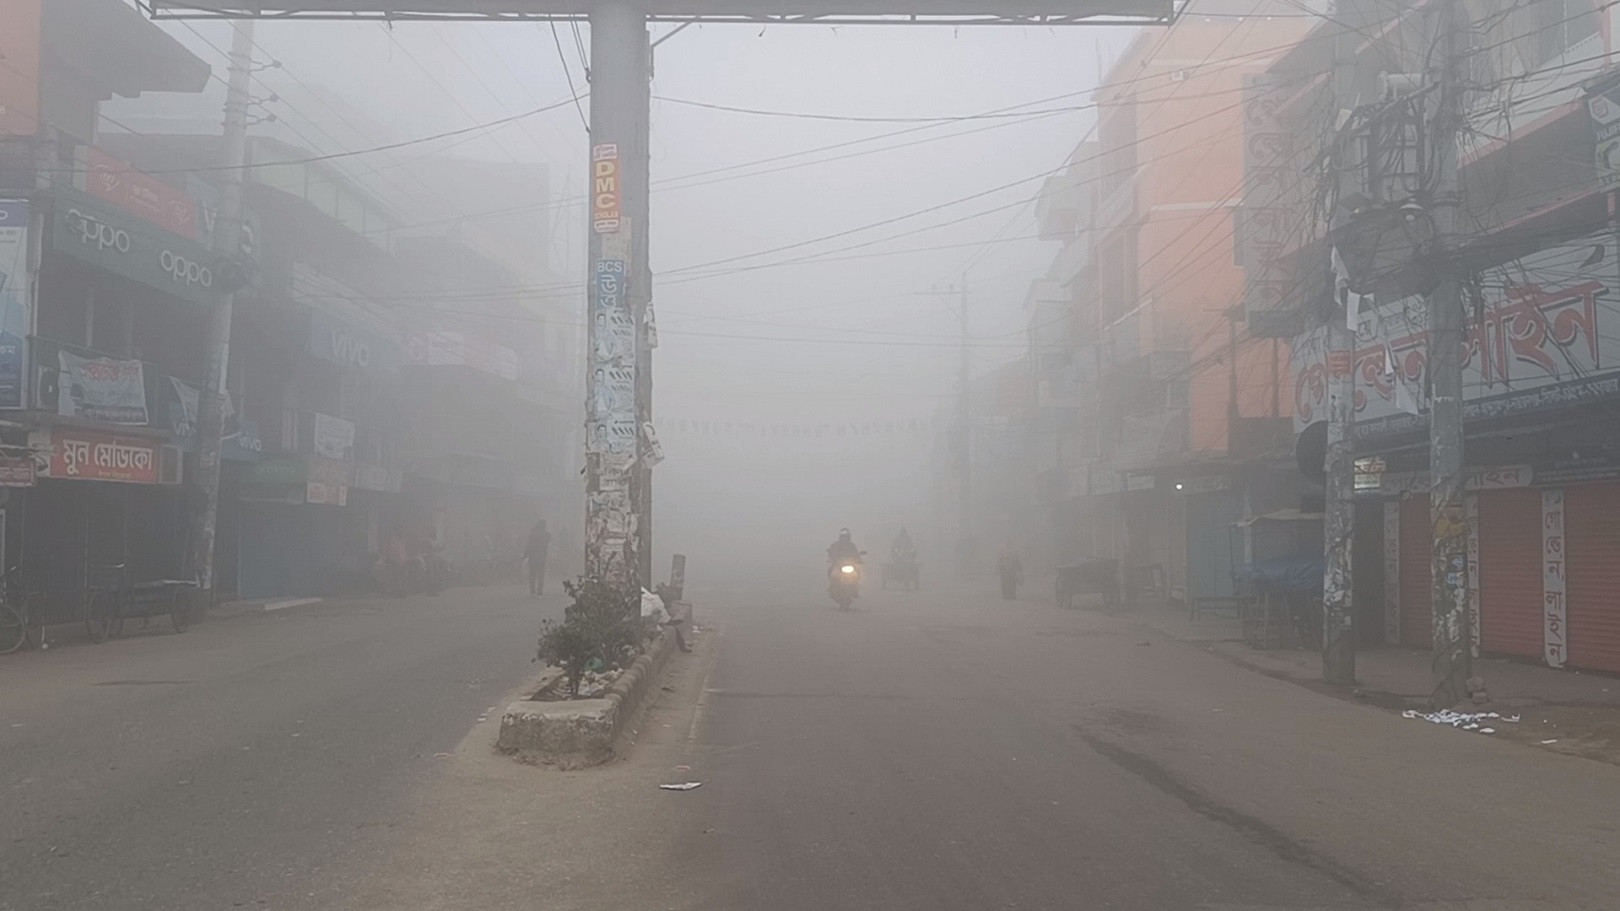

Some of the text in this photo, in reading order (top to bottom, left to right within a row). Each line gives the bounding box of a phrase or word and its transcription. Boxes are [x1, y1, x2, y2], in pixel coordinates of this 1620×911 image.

[596, 161, 616, 209] DMC
[65, 208, 131, 253] oppo
[160, 249, 212, 288] oppo
[597, 261, 622, 272] BCS
[331, 328, 370, 367] vivo
[63, 439, 90, 475] মুন
